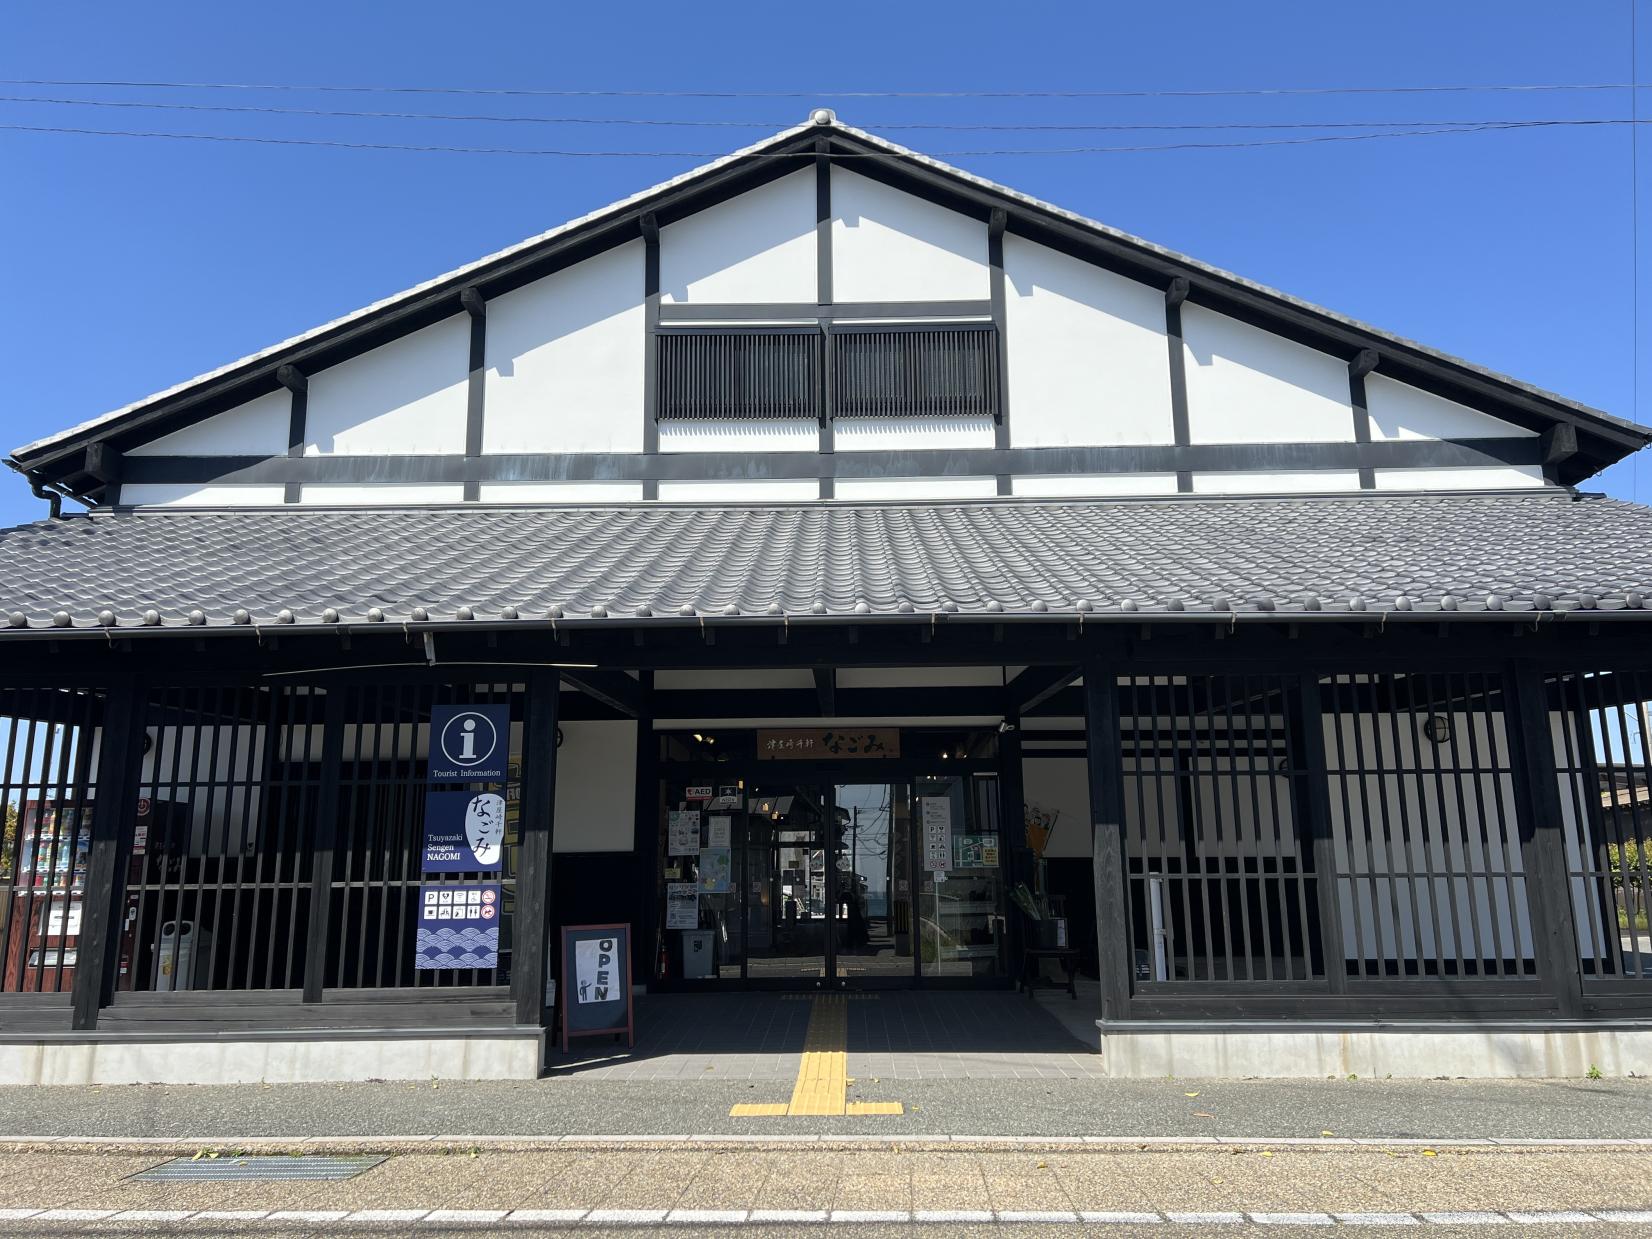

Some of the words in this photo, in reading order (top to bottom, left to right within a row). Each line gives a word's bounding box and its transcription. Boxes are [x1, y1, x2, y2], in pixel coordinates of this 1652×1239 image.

[822, 732, 885, 754] なごみ
[433, 769, 458, 778] Tourist
[460, 768, 501, 778] Information
[695, 788, 711, 796] AED
[495, 799, 504, 836] 津屋崎千軒
[472, 795, 494, 857] なごみ
[428, 833, 463, 843] Tsuyazaki
[427, 843, 454, 852] Sengen
[426, 852, 461, 861] NAGOMI
[595, 939, 613, 1001] OPEN
